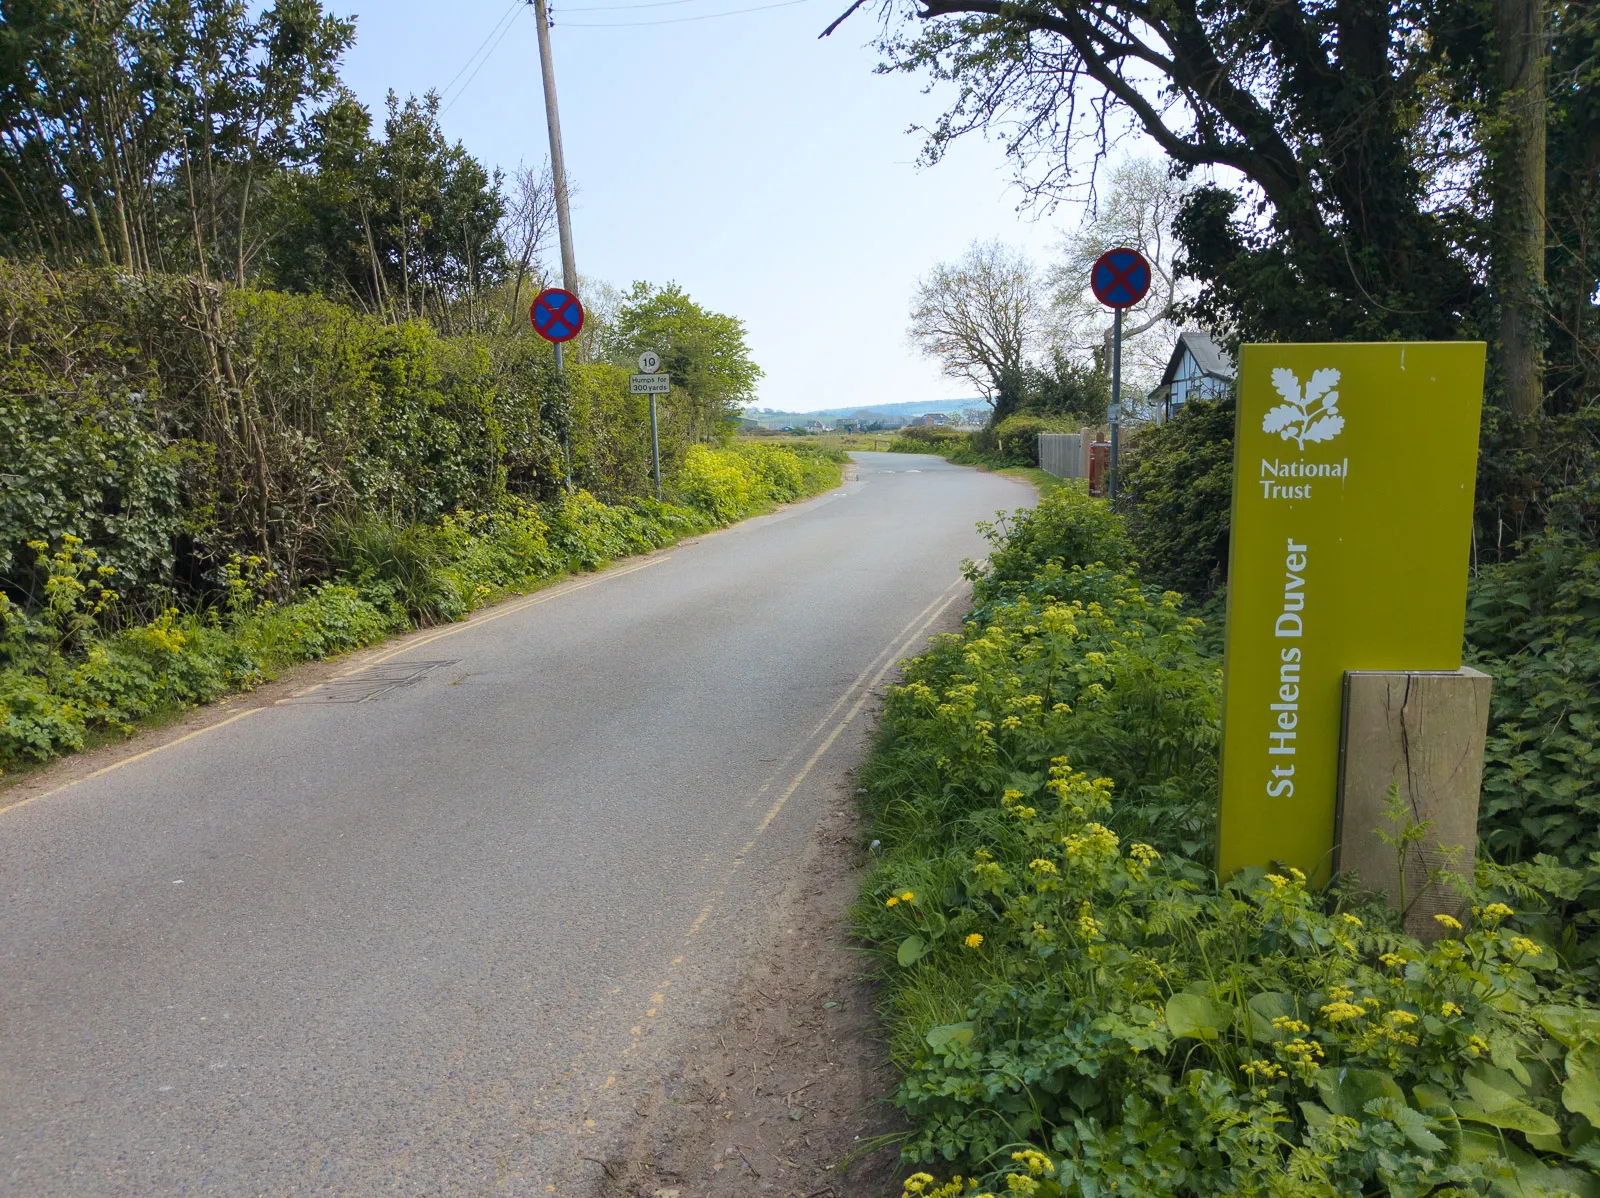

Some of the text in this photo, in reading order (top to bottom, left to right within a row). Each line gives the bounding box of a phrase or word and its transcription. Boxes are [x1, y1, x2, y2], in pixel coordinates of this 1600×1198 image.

[643, 357, 656, 367] 10
[1261, 457, 1348, 477] National
[1259, 480, 1312, 499] Trust
[1266, 537, 1307, 798] St Helens Duver
